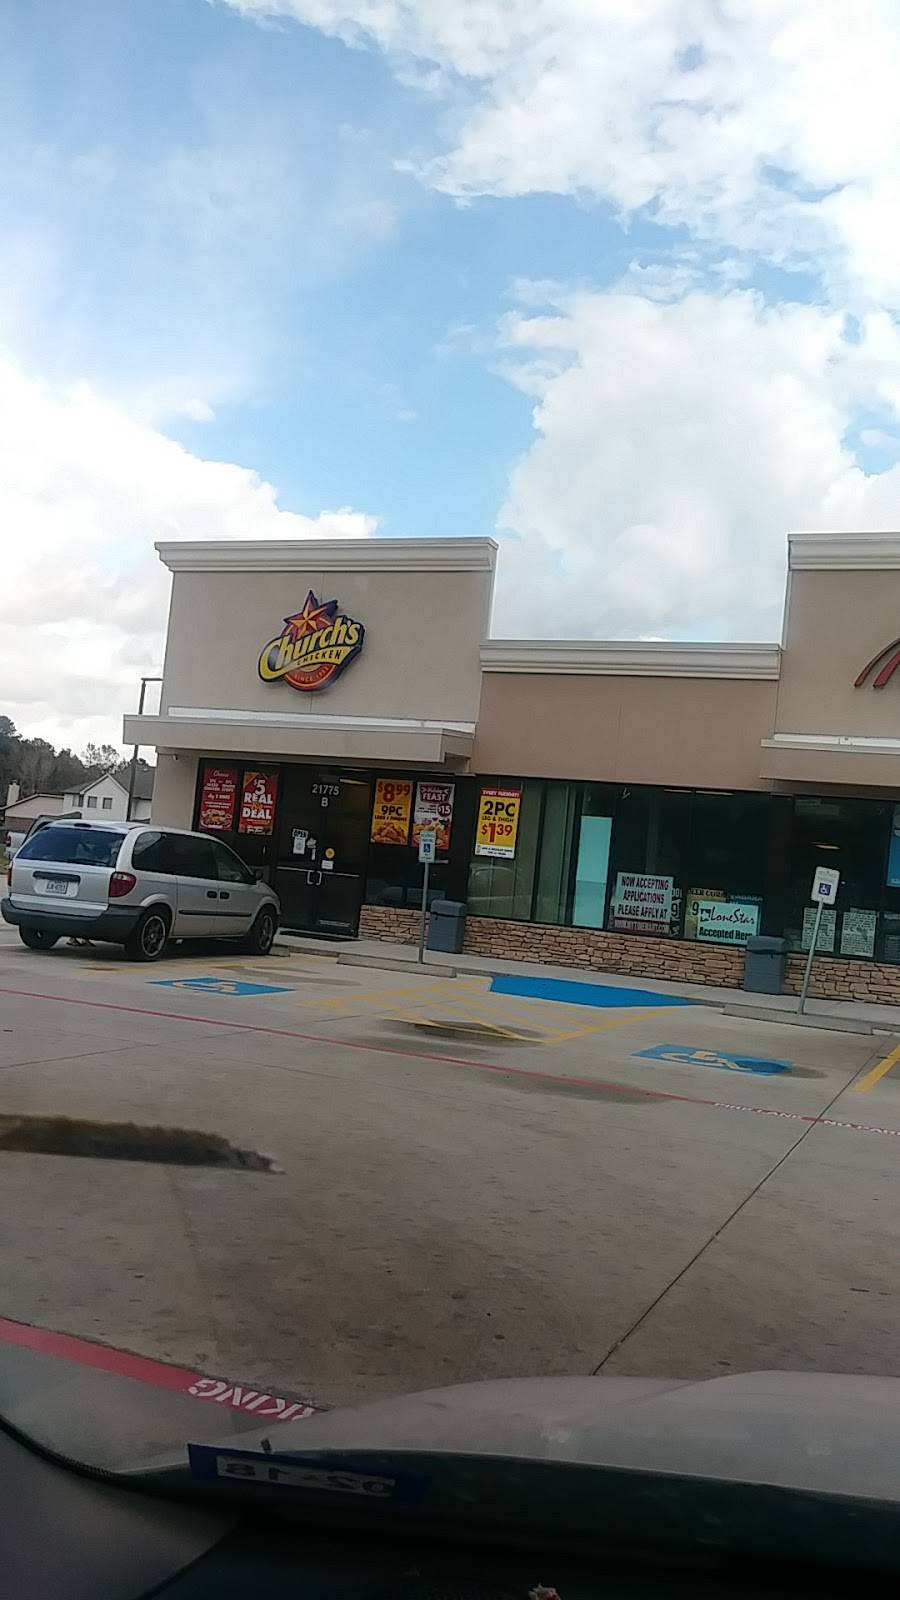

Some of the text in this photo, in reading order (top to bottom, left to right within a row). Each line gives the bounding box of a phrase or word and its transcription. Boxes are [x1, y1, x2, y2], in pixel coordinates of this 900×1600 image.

[259, 616, 359, 680] Church's
[296, 649, 342, 666] CHICKEN
[253, 779, 266, 795] $5
[312, 784, 340, 796] 21775
[244, 792, 273, 804] REAL
[422, 792, 446, 801] FEAST
[242, 807, 272, 820] DEAL
[381, 805, 403, 817] 9PC
[483, 800, 516, 817] 2PC
[621, 876, 669, 890] NOW ACCEPTING
[623, 890, 665, 904] APPLICATIONS
[618, 904, 668, 919] PLEASE APPLY AT
[698, 927, 734, 939] Accepted
